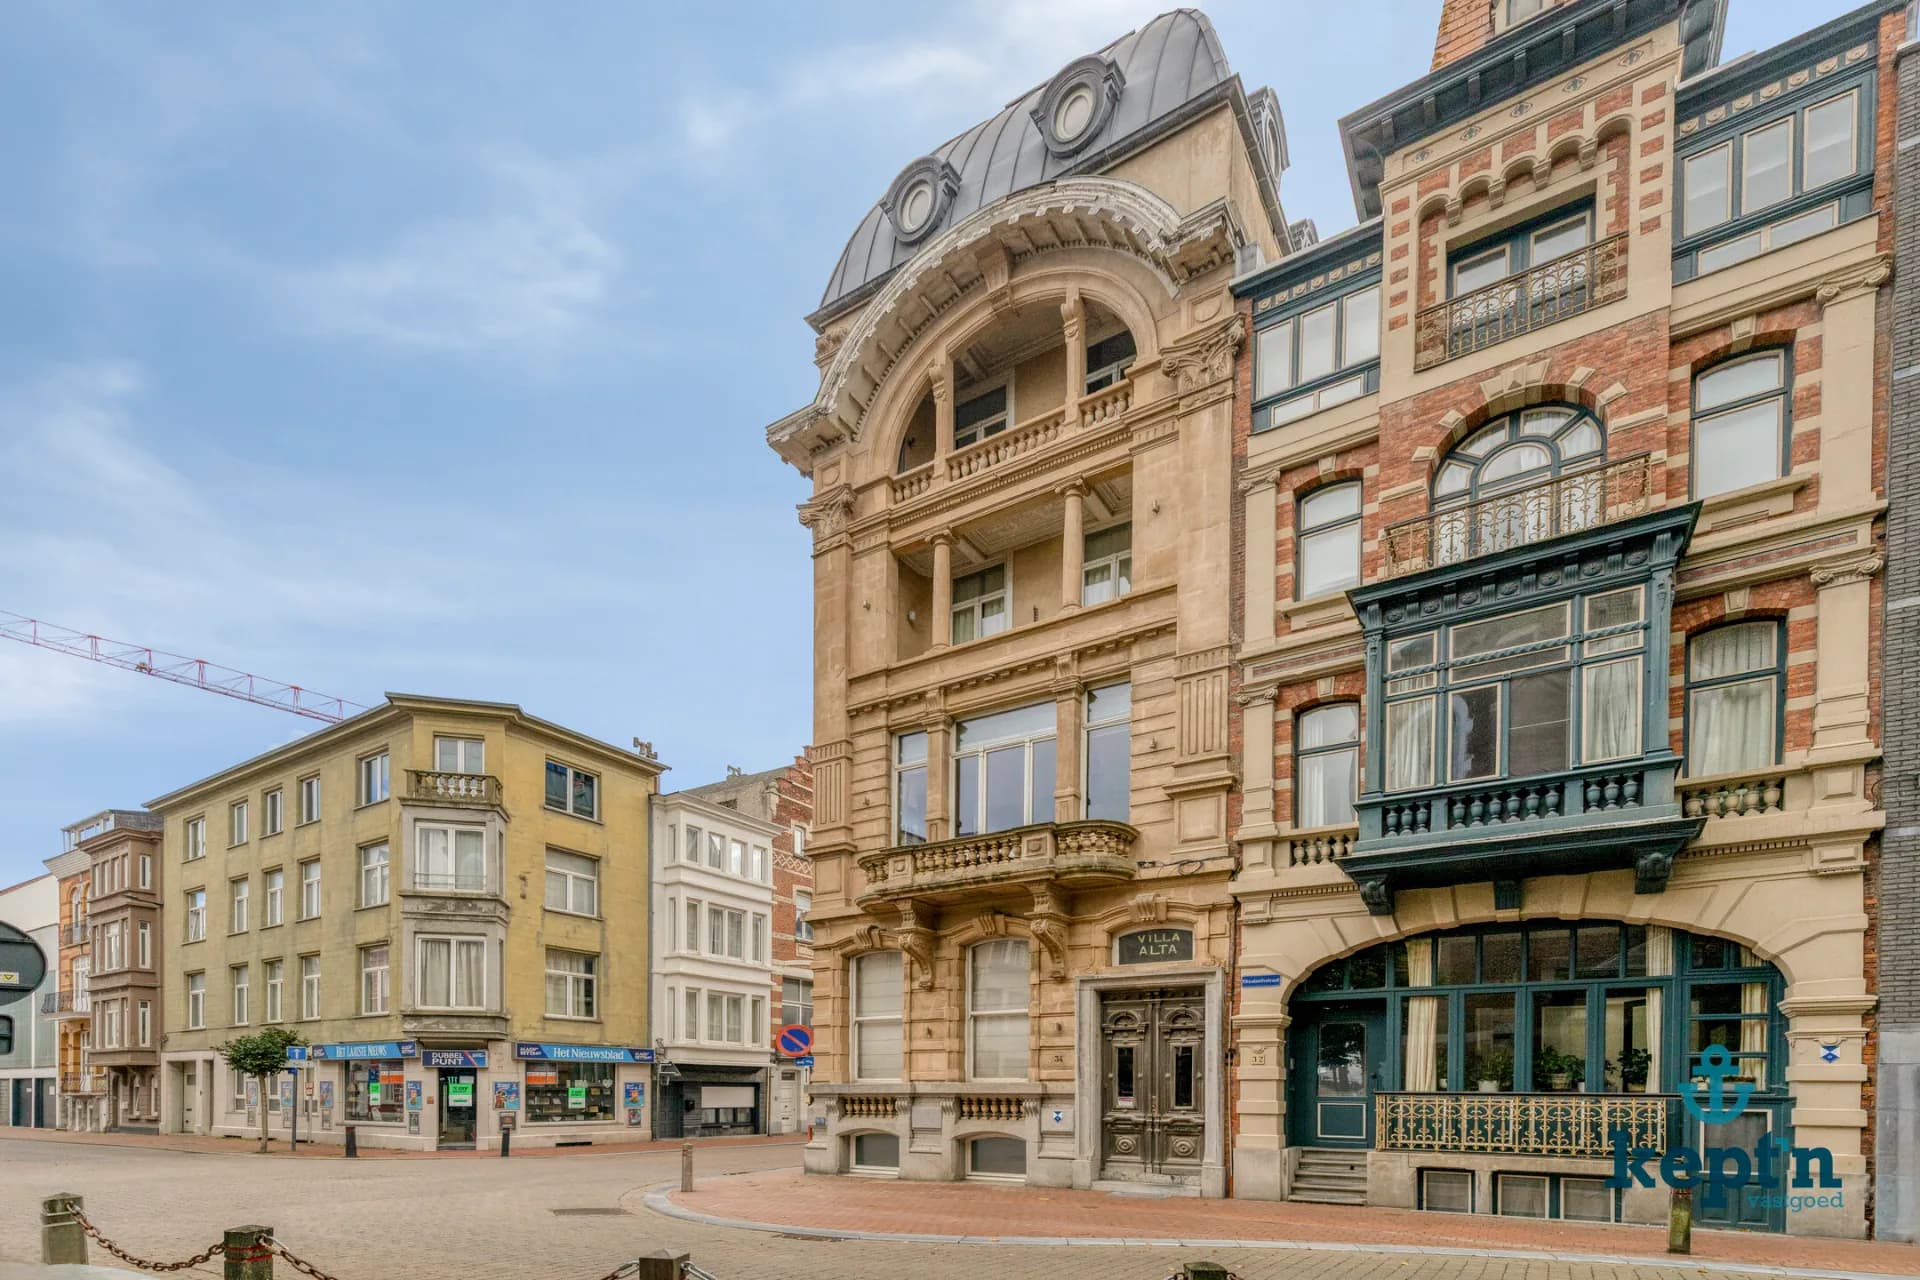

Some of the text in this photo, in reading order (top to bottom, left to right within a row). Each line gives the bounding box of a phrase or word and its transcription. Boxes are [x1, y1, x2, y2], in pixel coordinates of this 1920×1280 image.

[1137, 933, 1180, 943] VILLA
[1139, 944, 1177, 956] ALTA
[553, 1048, 569, 1058] Het
[571, 1048, 624, 1060] Nieuwsblad
